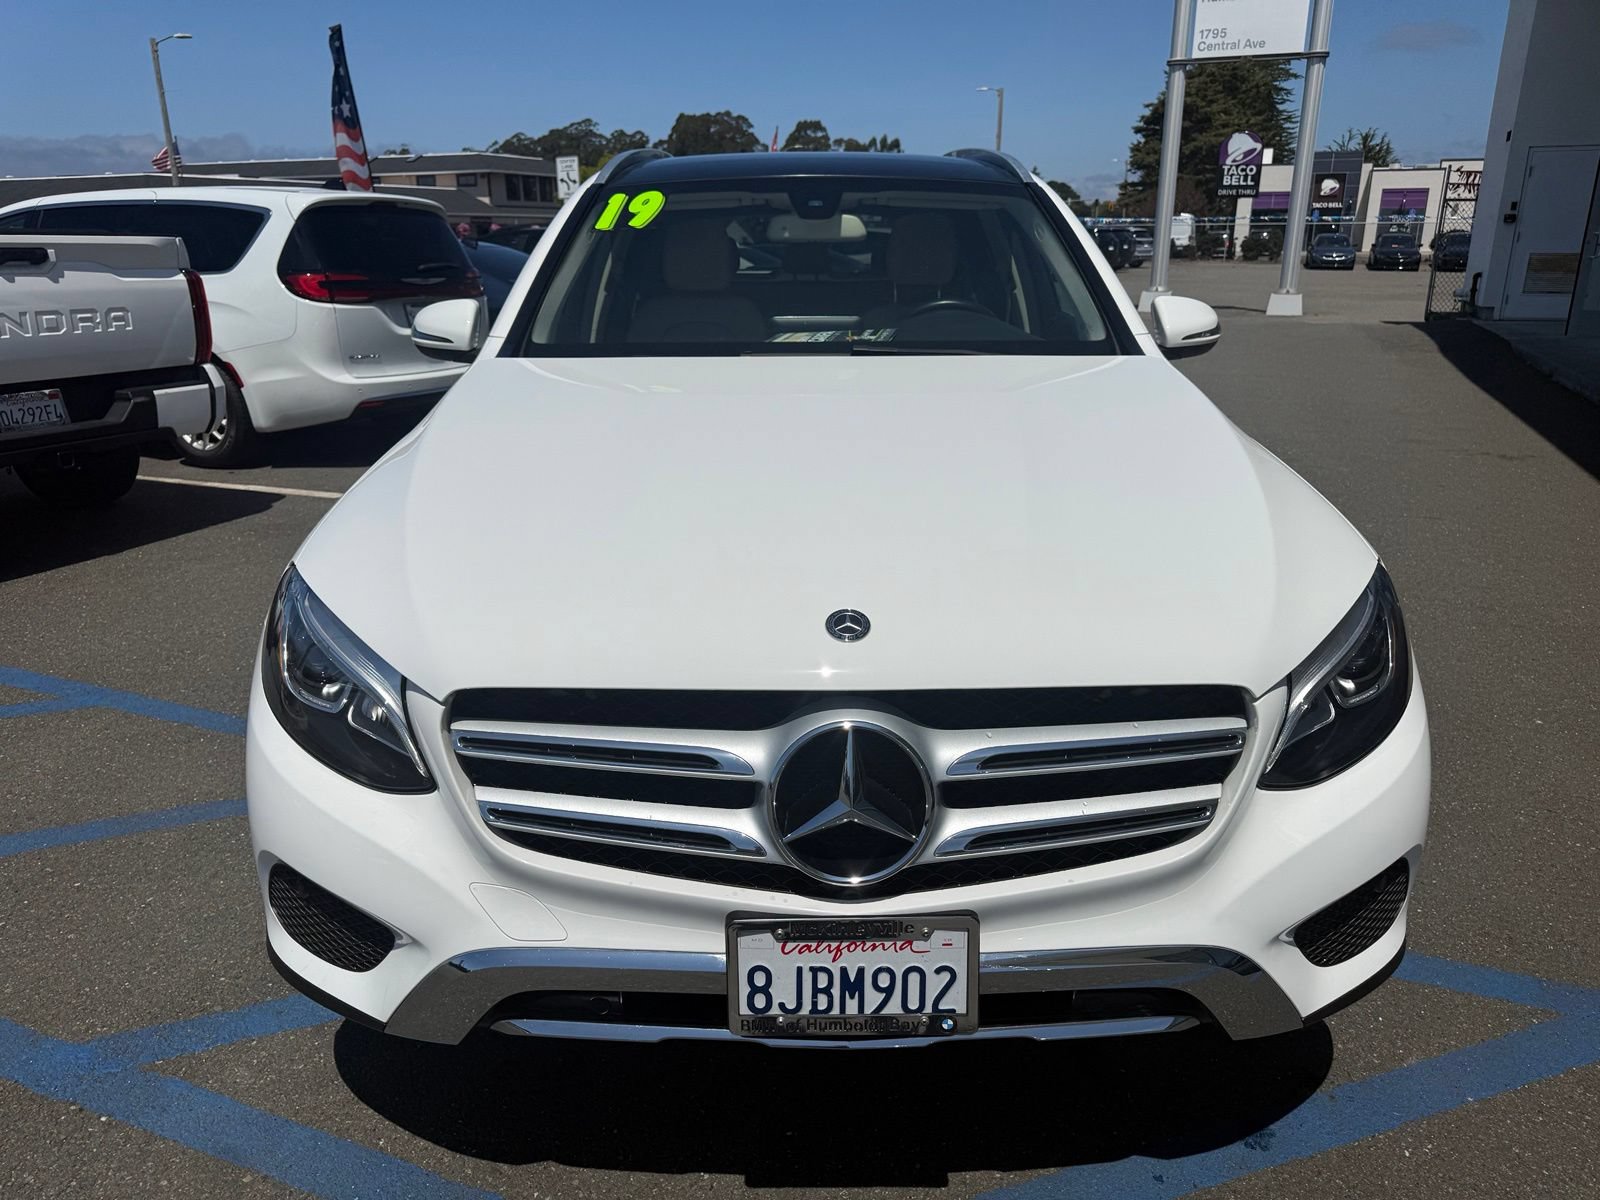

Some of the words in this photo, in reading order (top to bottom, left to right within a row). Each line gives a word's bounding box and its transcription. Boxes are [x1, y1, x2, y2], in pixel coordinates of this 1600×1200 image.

[1199, 27, 1228, 40] 1795
[1197, 39, 1241, 52] Central
[1243, 38, 1266, 49] Ave
[1222, 165, 1257, 176] TACO
[1222, 175, 1255, 186] BELL
[1238, 188, 1257, 196] THRU
[594, 190, 666, 231] 19
[0, 307, 133, 338] NDRA
[780, 940, 931, 963] California
[746, 965, 957, 1015] 8JBM902
[806, 1018, 884, 1033] Humboldt
[891, 1018, 920, 1034] Bay
